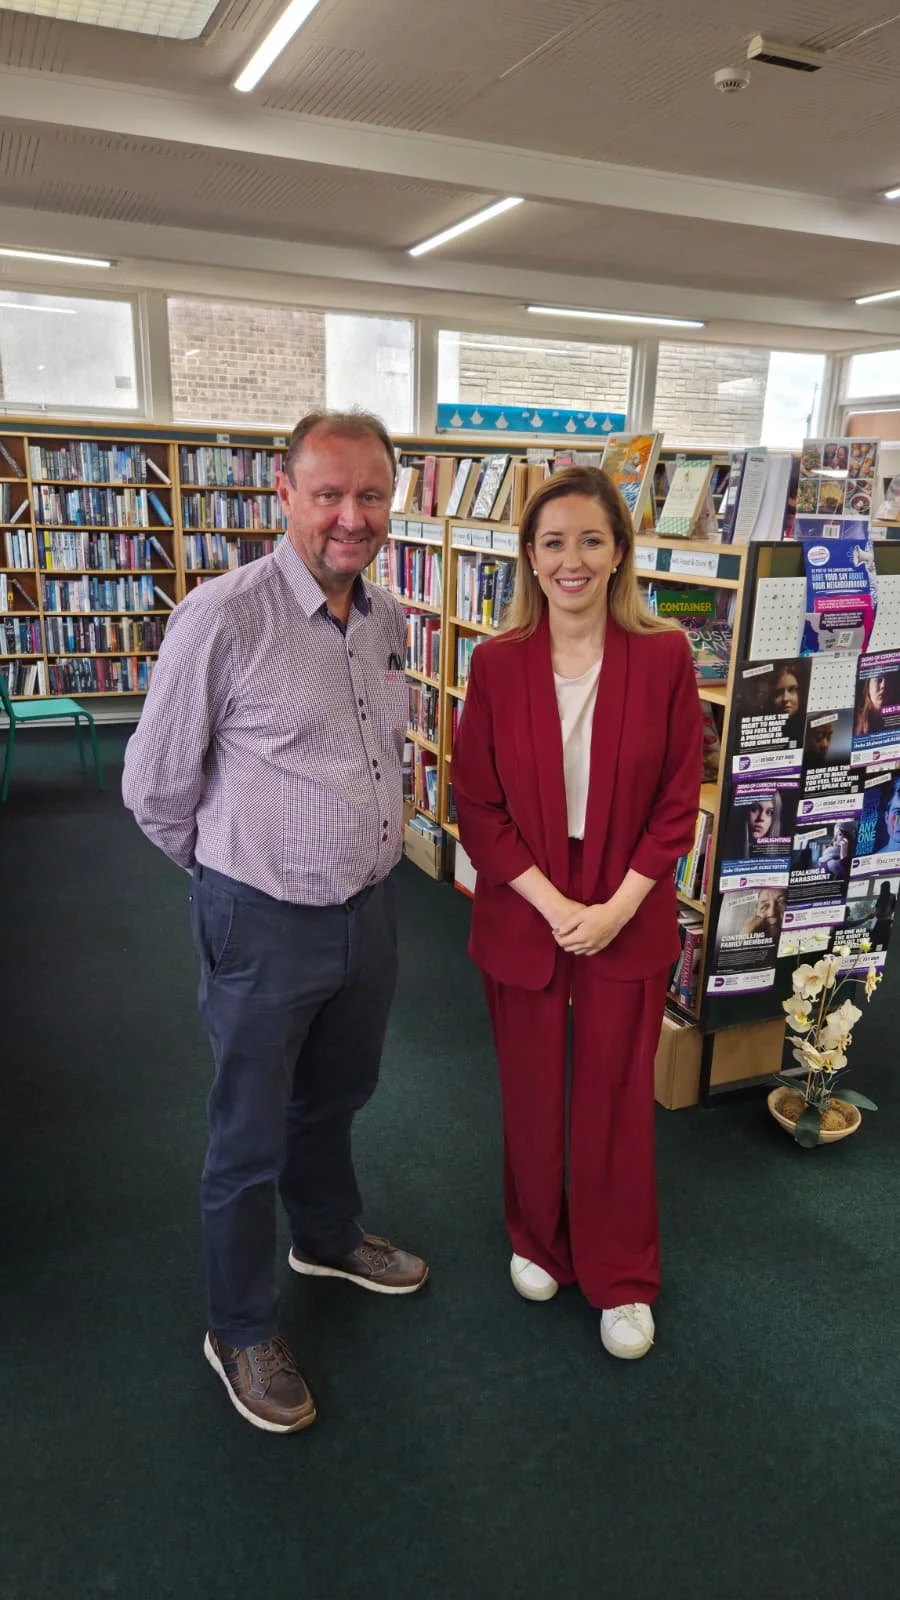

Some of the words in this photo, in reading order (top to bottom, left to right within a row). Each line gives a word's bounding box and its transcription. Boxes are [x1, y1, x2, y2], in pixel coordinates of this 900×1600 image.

[660, 602, 712, 612] CONTAINER
[687, 630, 733, 641] OUSE
[740, 740, 756, 748] YOUR
[858, 820, 878, 834] ANY
[857, 830, 877, 843] ONE
[791, 868, 820, 876] STALKING
[790, 873, 831, 883] HARASSMENT
[721, 932, 765, 942] CONTROLLING
[720, 941, 743, 949] FAMILY
[743, 937, 773, 946] MEMBERS
